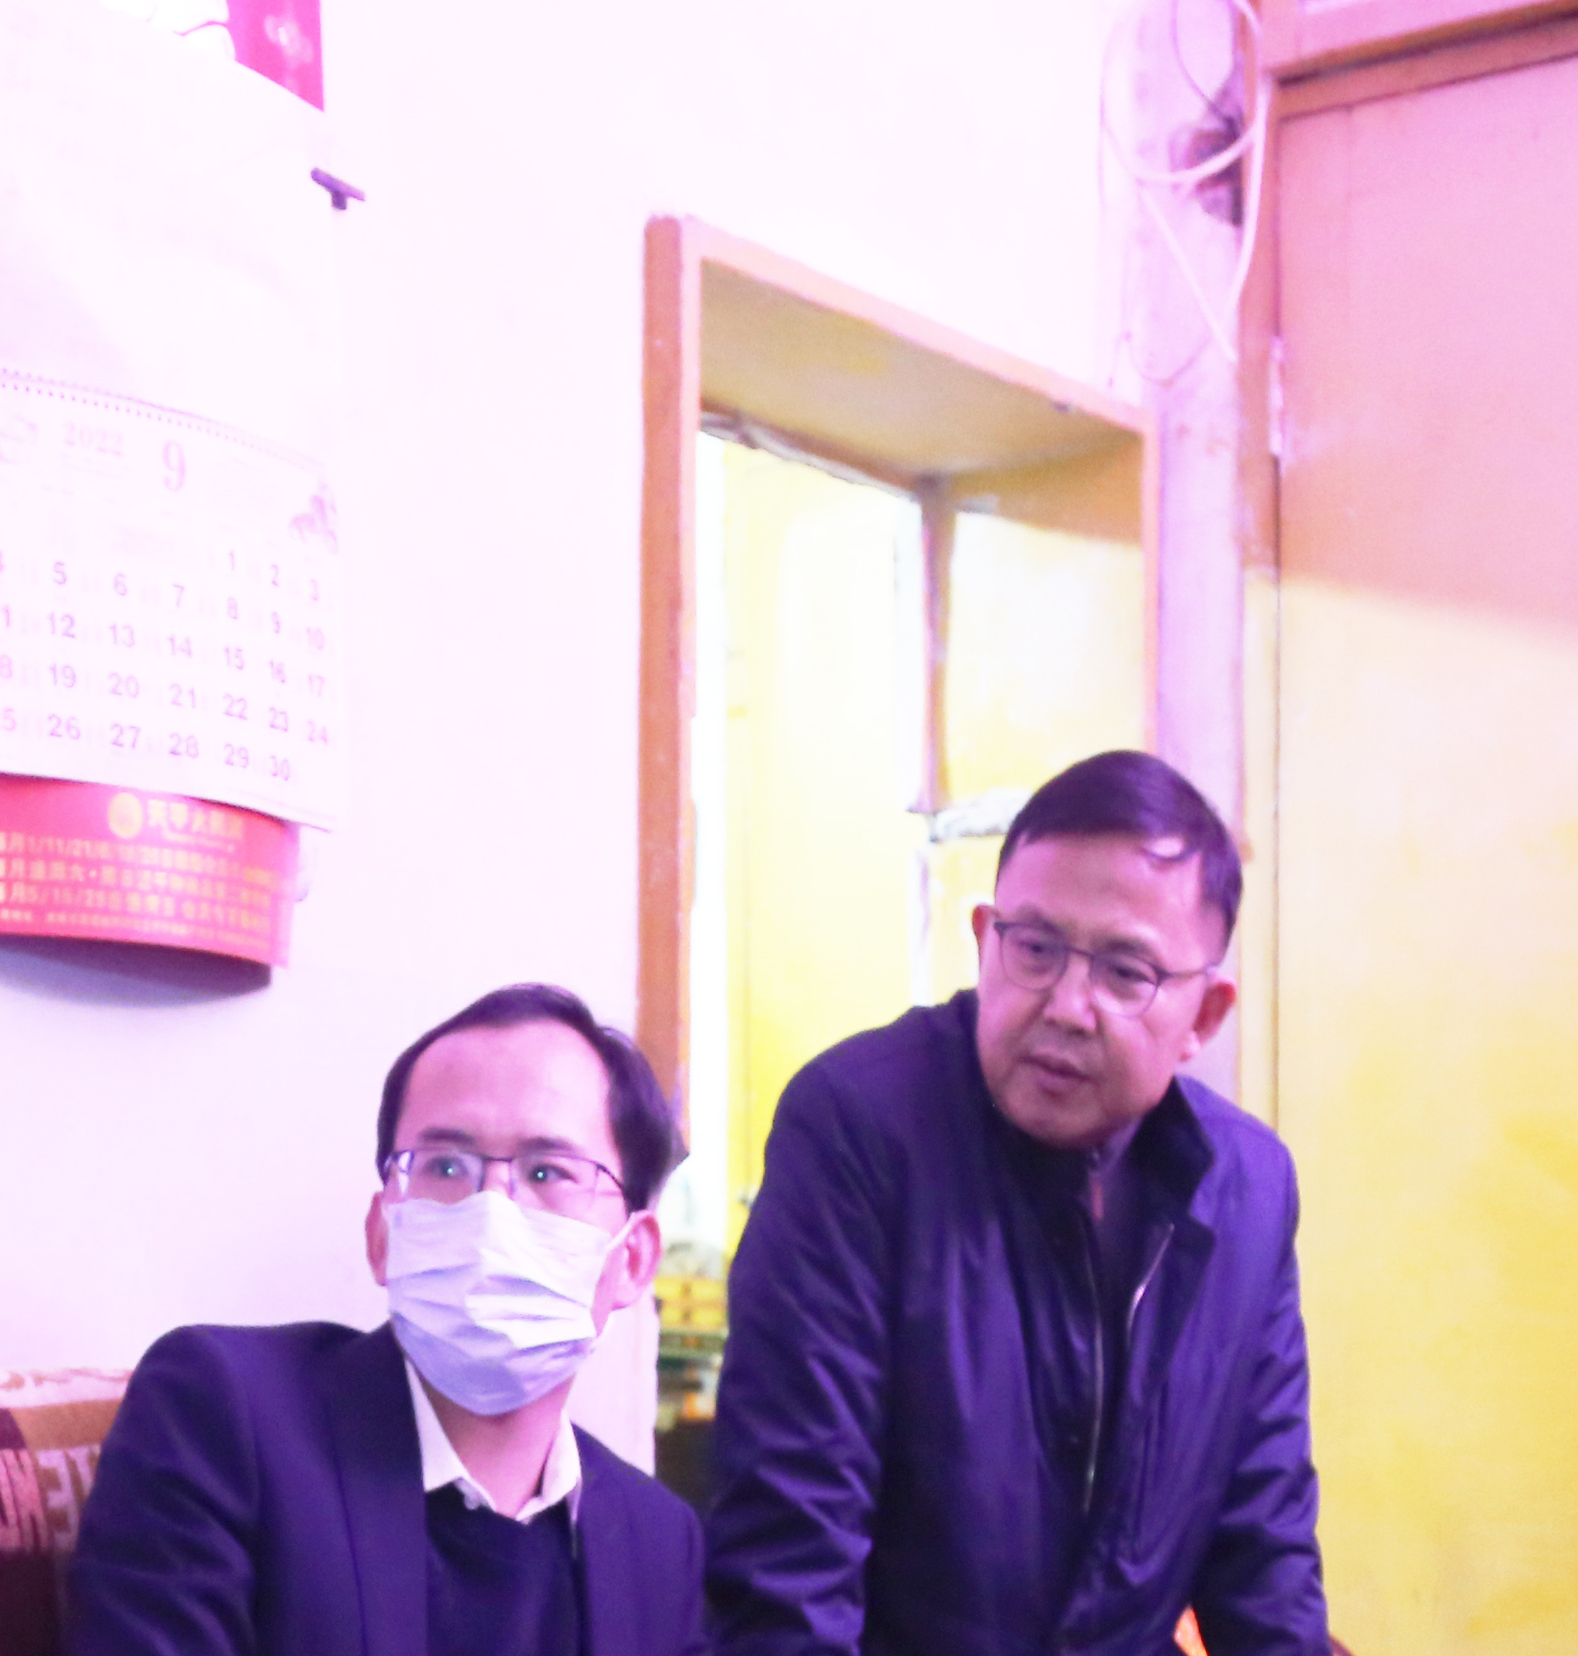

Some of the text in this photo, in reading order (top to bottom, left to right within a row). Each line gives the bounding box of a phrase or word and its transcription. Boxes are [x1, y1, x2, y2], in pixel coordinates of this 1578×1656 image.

[63, 420, 123, 456] 2022
[161, 439, 187, 492] 9
[53, 560, 68, 586] 5
[112, 572, 128, 598] 6
[172, 583, 186, 608] 7
[227, 549, 320, 603] 1 2 3
[48, 612, 77, 640] 12
[108, 623, 136, 649] 13
[167, 634, 193, 658] 14
[223, 646, 245, 671] 15
[307, 673, 326, 698] 17
[48, 663, 77, 689] 19
[108, 671, 140, 699] 20
[169, 682, 197, 709] 21
[223, 693, 248, 721] 22
[268, 706, 289, 733] 23
[307, 719, 329, 745] 24
[47, 713, 82, 740] 26
[110, 722, 141, 750] 27
[168, 734, 199, 758] 28
[223, 742, 250, 769] 29
[270, 755, 291, 782] 30
